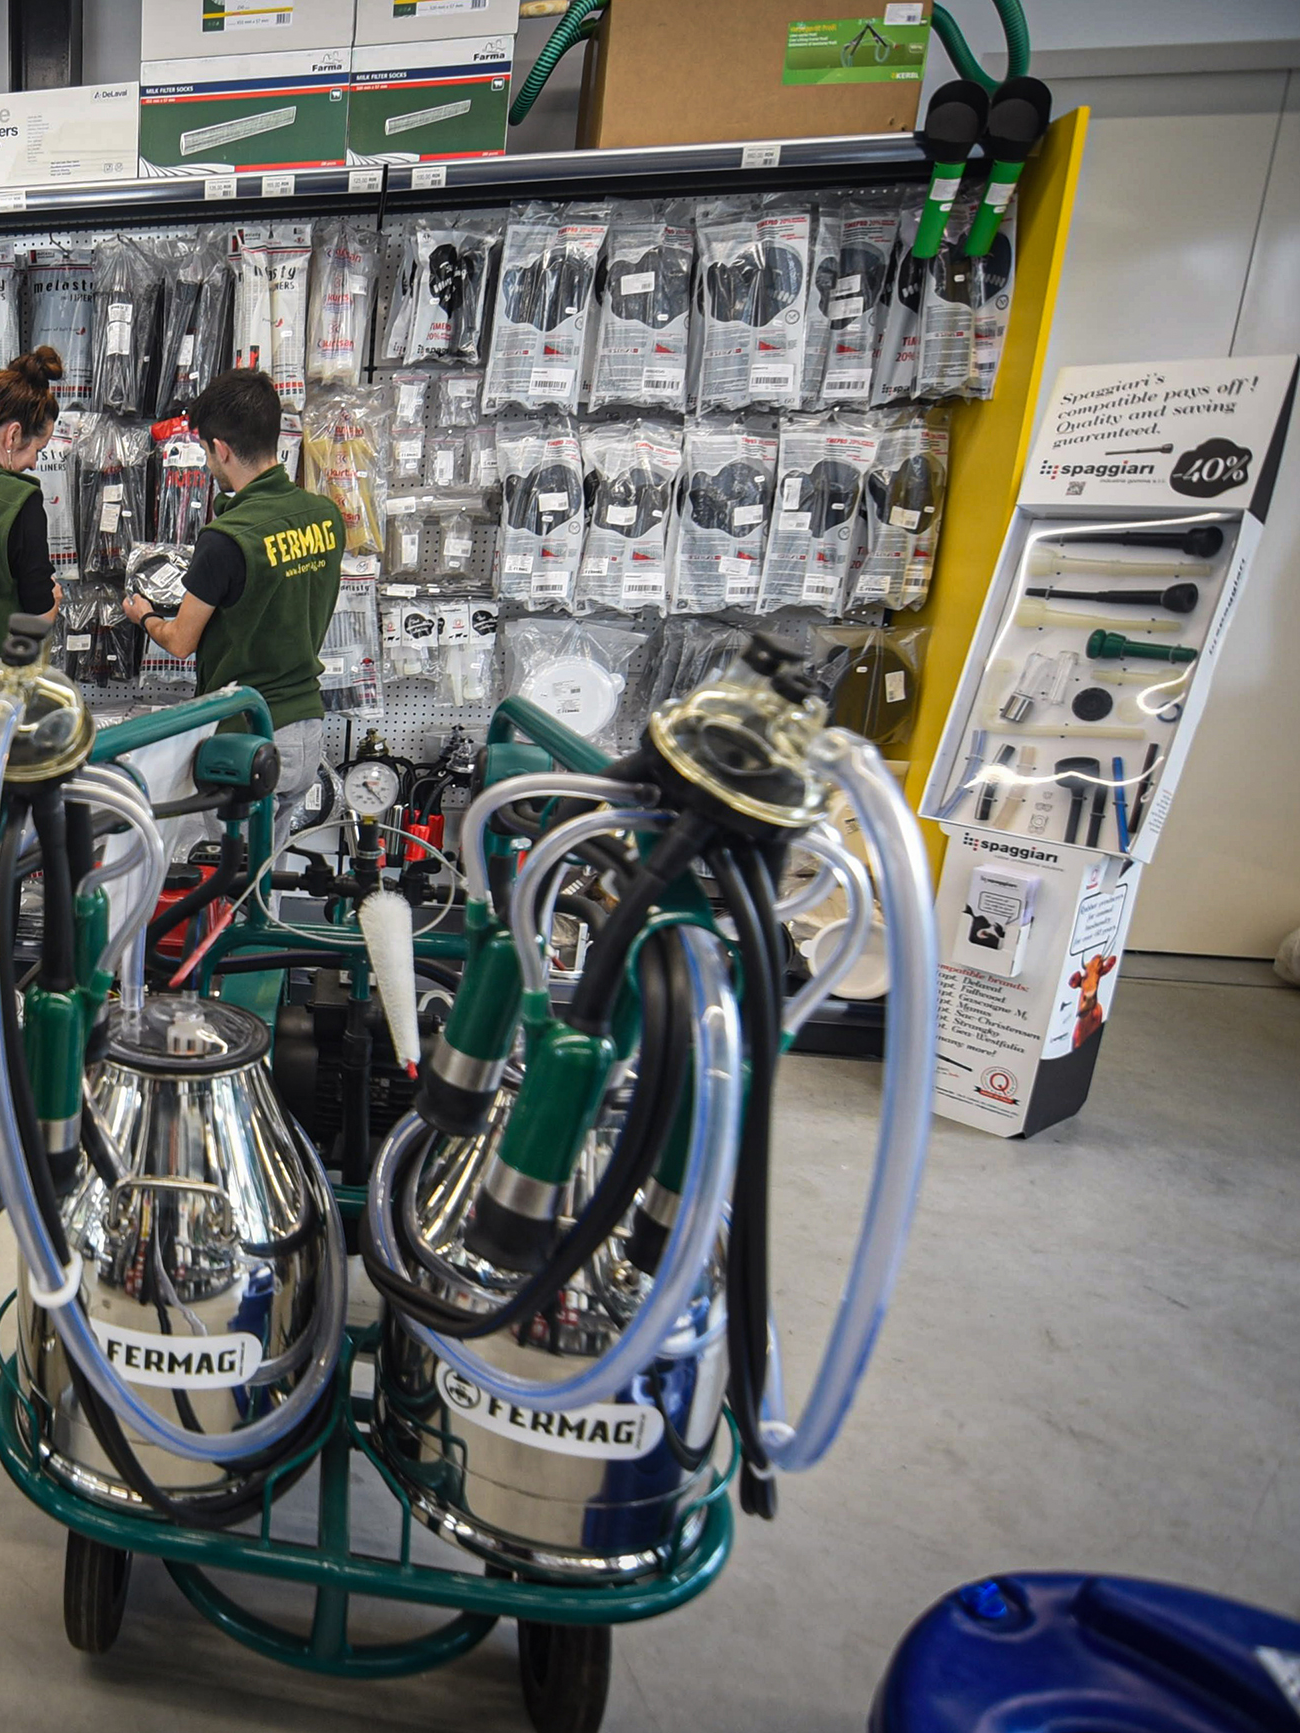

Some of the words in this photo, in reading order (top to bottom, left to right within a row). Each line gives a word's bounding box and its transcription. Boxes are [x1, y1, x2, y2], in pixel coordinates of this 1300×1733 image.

[311, 62, 343, 73] Farma
[473, 50, 506, 62] Farma
[102, 89, 128, 98] DeLaval
[159, 86, 176, 94] FILTER
[176, 85, 194, 93] SOCKS
[895, 351, 915, 362] 20%
[1057, 392, 1158, 420] compatible
[1163, 385, 1211, 401] pays
[1060, 373, 1166, 406] Spaggiari's
[1055, 412, 1123, 434] Quality
[1128, 404, 1167, 420] and
[1172, 400, 1237, 416] saving
[1052, 423, 1162, 449] guaranteed.
[1060, 459, 1156, 477] spaggiari
[1172, 455, 1249, 483] -40%
[263, 520, 337, 567] FERMAG
[980, 839, 1058, 863] spaggiari
[107, 1338, 237, 1375] FERMAG
[488, 1397, 637, 1445] FERMAG
